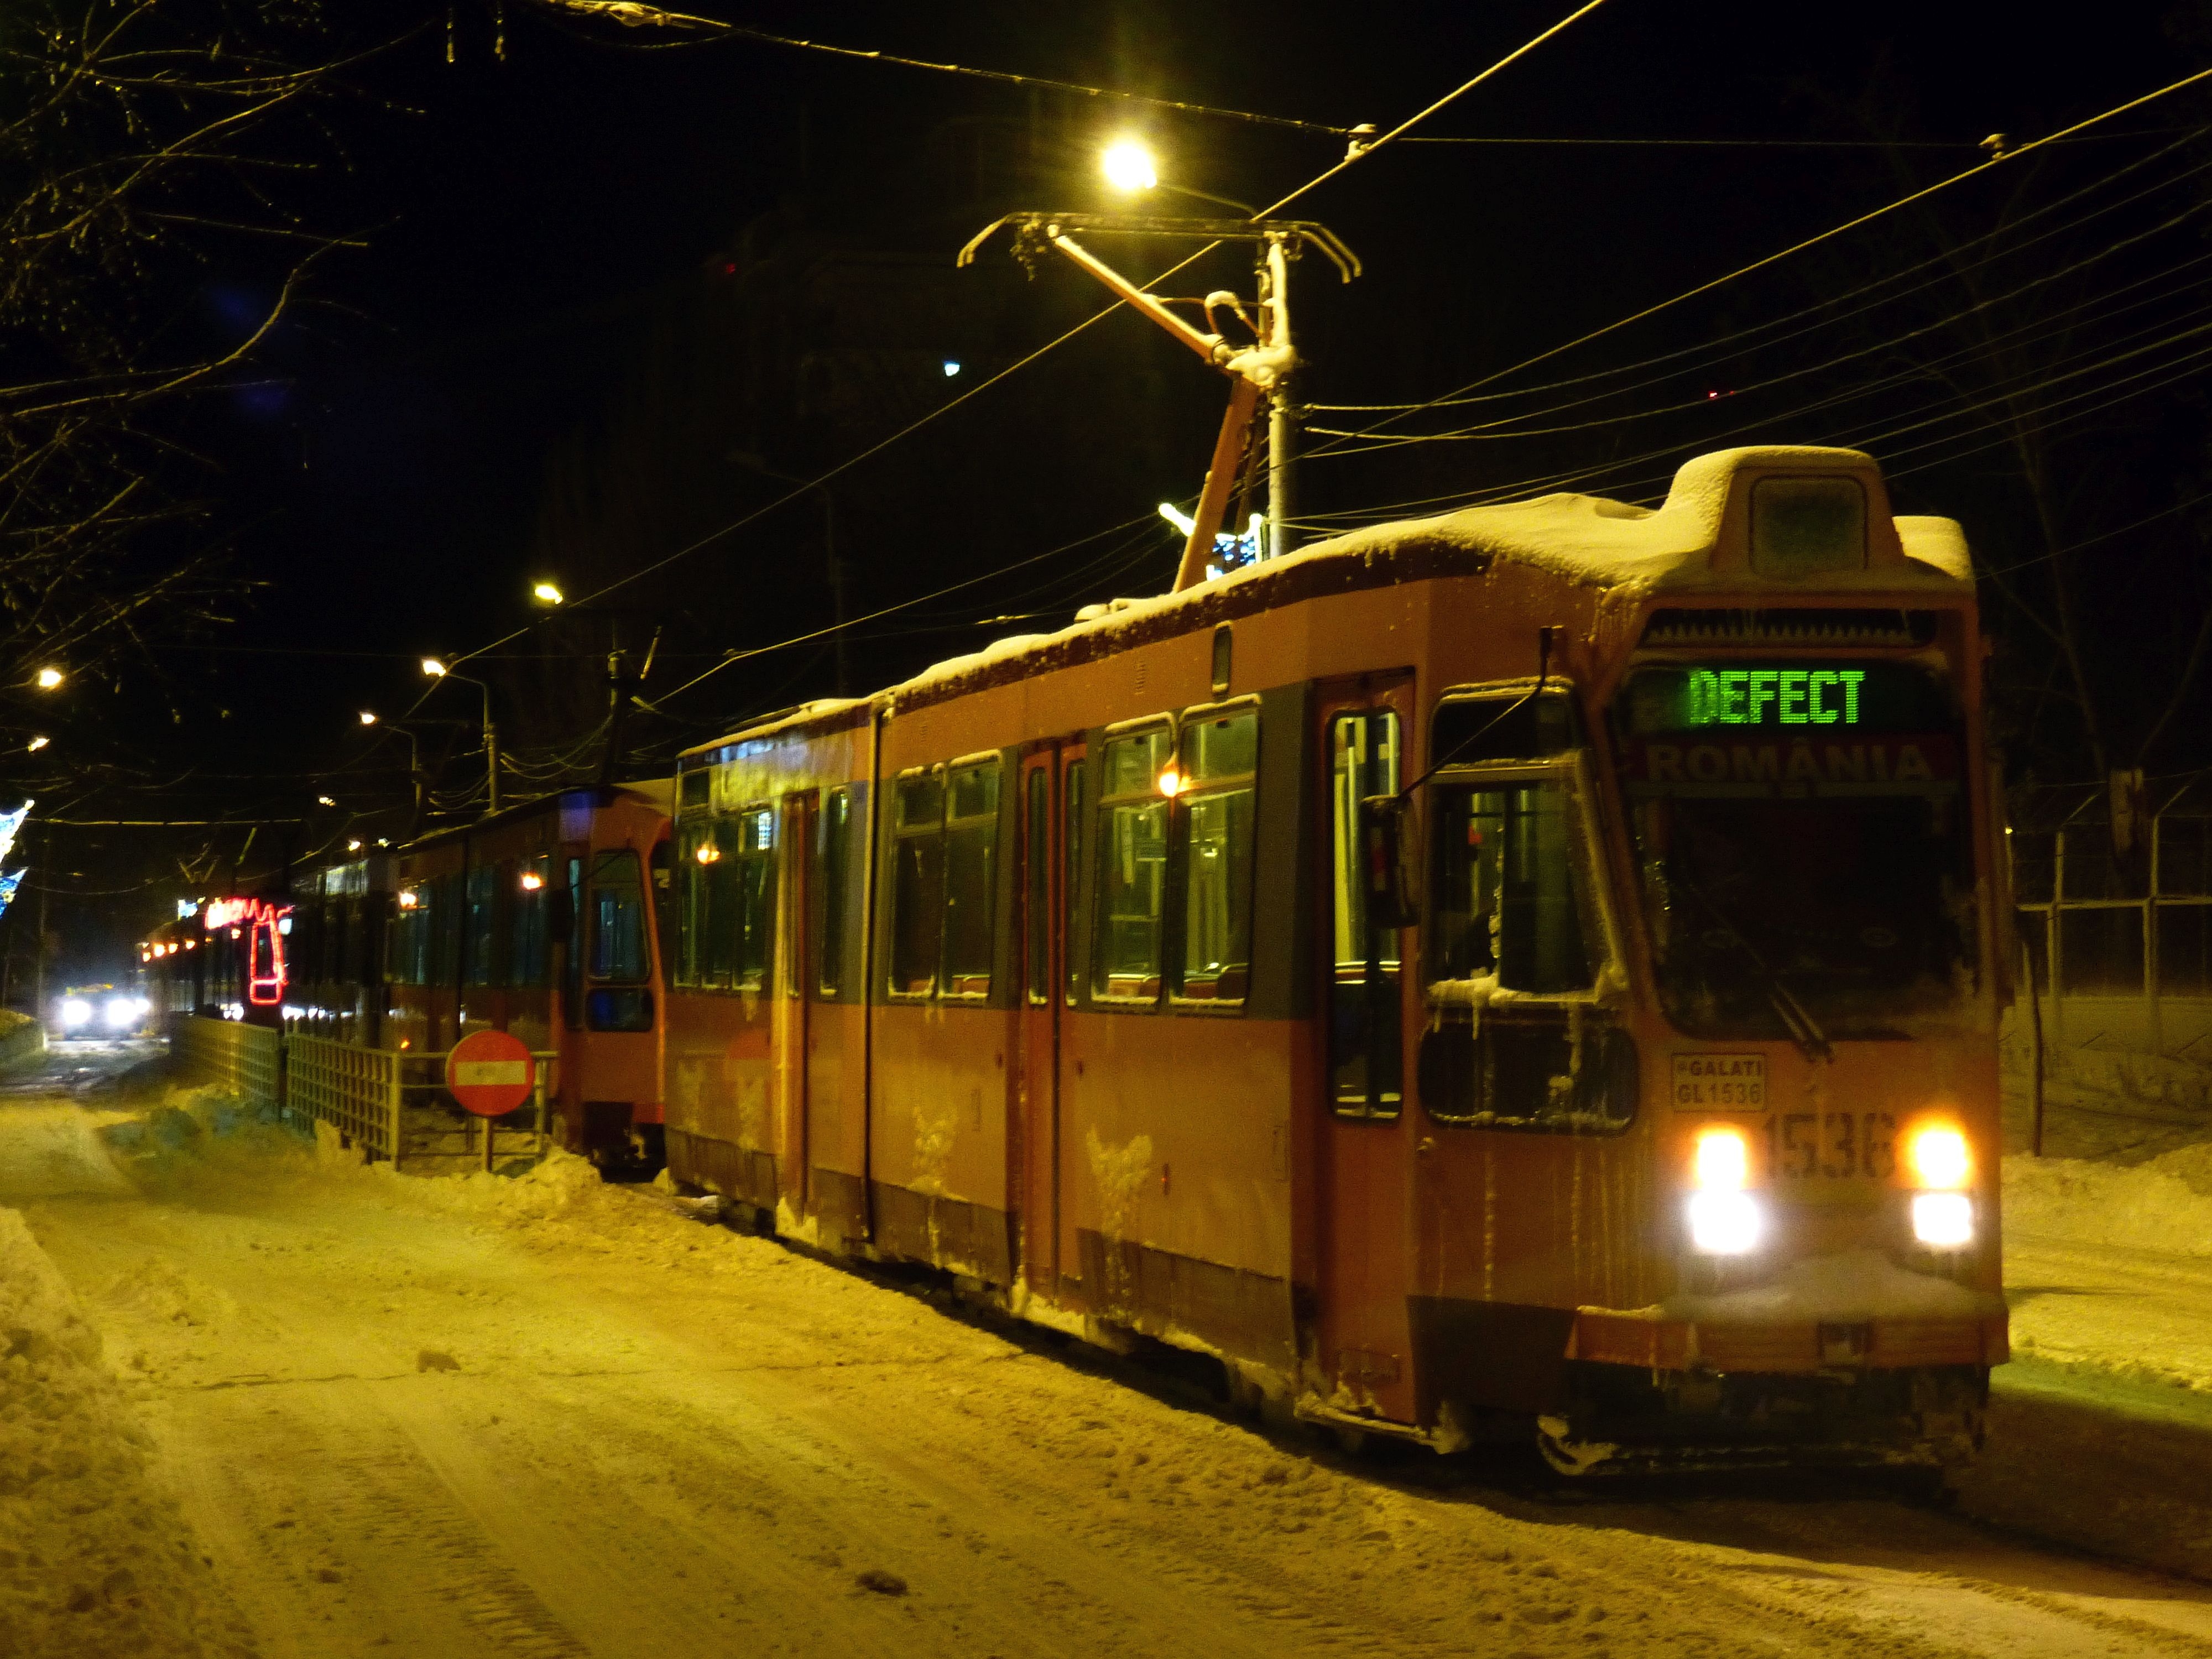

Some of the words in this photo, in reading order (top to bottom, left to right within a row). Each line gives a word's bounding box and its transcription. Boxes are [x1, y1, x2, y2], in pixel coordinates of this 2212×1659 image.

[1690, 670, 1866, 724] DEFECT
[1646, 736, 1934, 780] ROMÂNIA
[1677, 1083, 1703, 1104] GL
[1708, 1083, 1761, 1104] 1536
[1764, 1112, 1897, 1179] 1536
